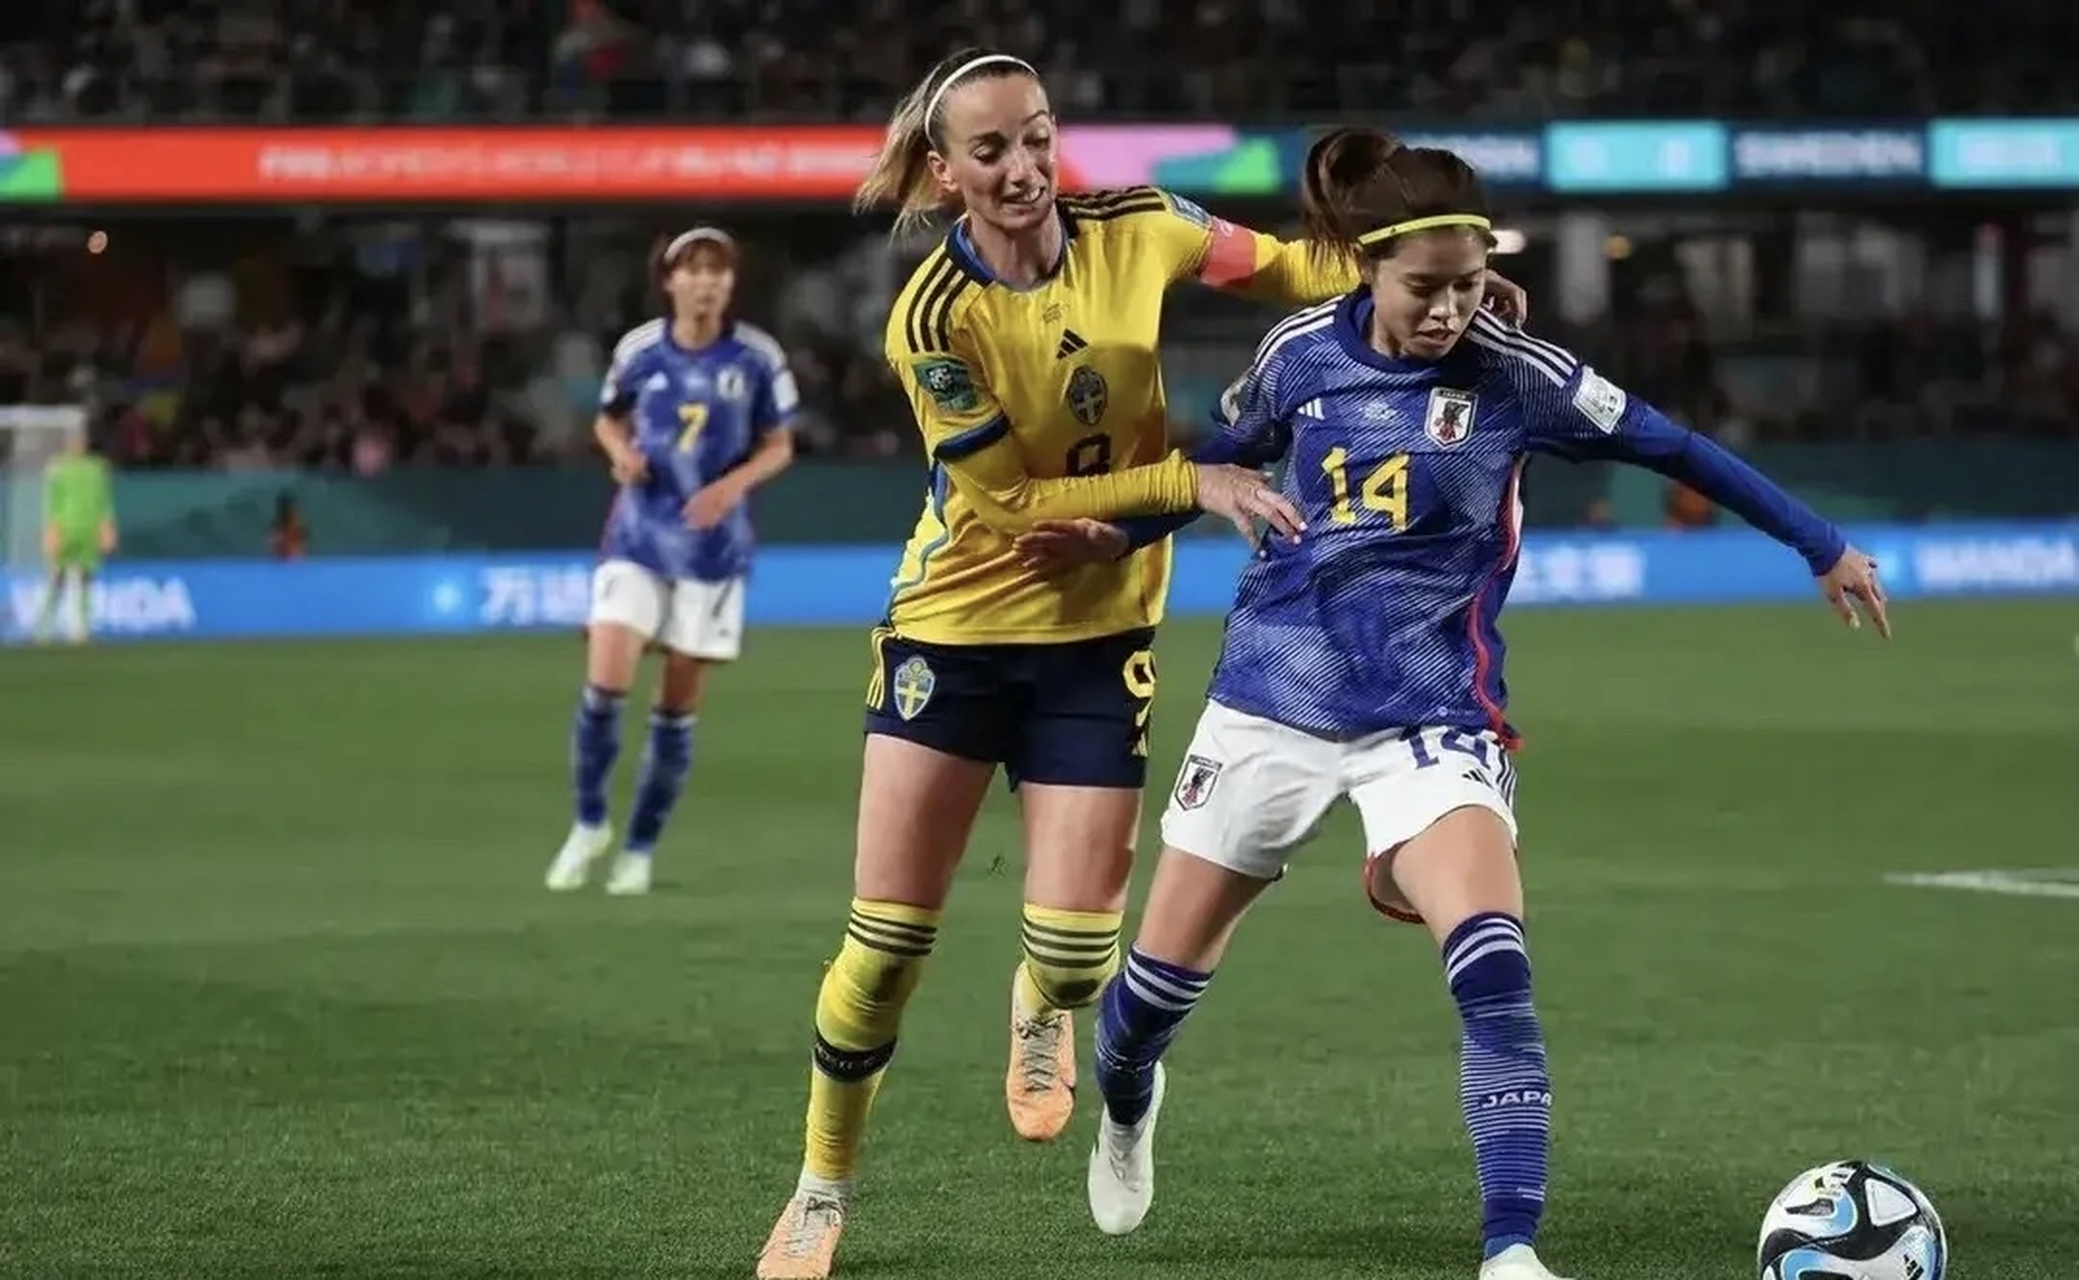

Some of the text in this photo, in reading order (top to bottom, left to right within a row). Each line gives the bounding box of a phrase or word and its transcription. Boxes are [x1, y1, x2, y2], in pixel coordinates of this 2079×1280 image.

[677, 403, 708, 455] 7
[1321, 447, 1410, 533] 14
[9, 574, 197, 632] WNDA
[1122, 650, 1158, 698] 9
[1407, 729, 1491, 770] 14
